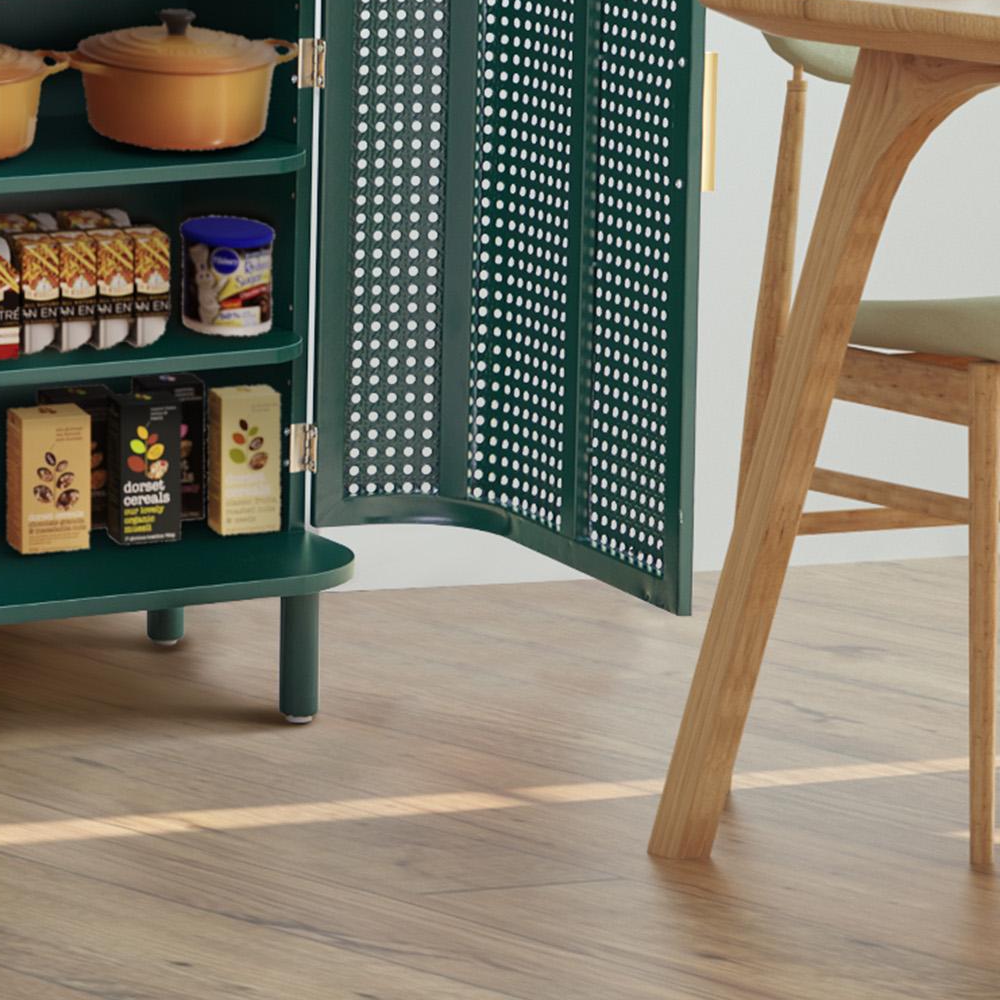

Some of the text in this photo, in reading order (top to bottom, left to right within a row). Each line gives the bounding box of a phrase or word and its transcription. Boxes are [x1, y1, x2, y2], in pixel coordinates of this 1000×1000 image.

[40, 307, 58, 318] EN
[78, 305, 95, 316] EN
[115, 302, 132, 313] EN
[123, 480, 166, 494] dorset
[123, 491, 171, 506] cereals
